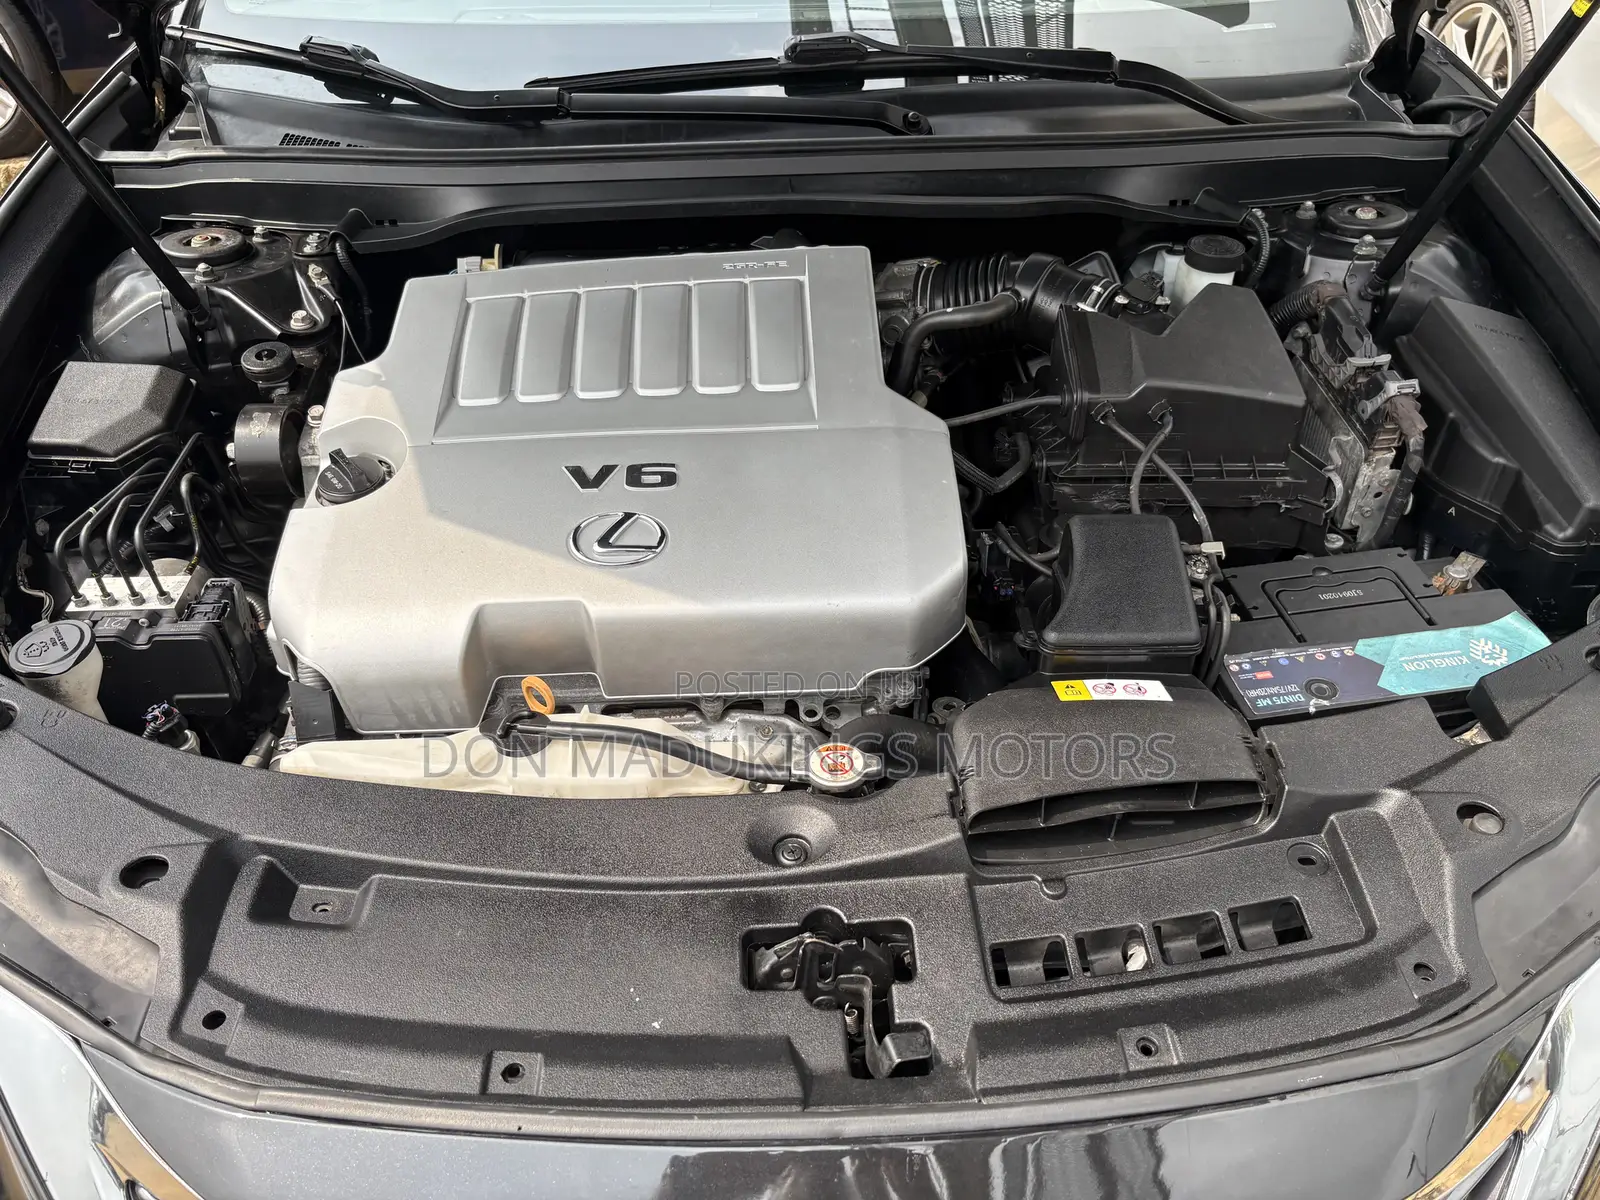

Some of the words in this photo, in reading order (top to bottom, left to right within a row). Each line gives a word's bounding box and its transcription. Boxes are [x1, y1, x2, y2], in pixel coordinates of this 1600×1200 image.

[562, 462, 679, 492] V6
[1447, 506, 1456, 516] A
[1402, 655, 1471, 672] KINGLION
[1256, 698, 1273, 707] MF
[1274, 693, 1305, 705] DIN75
